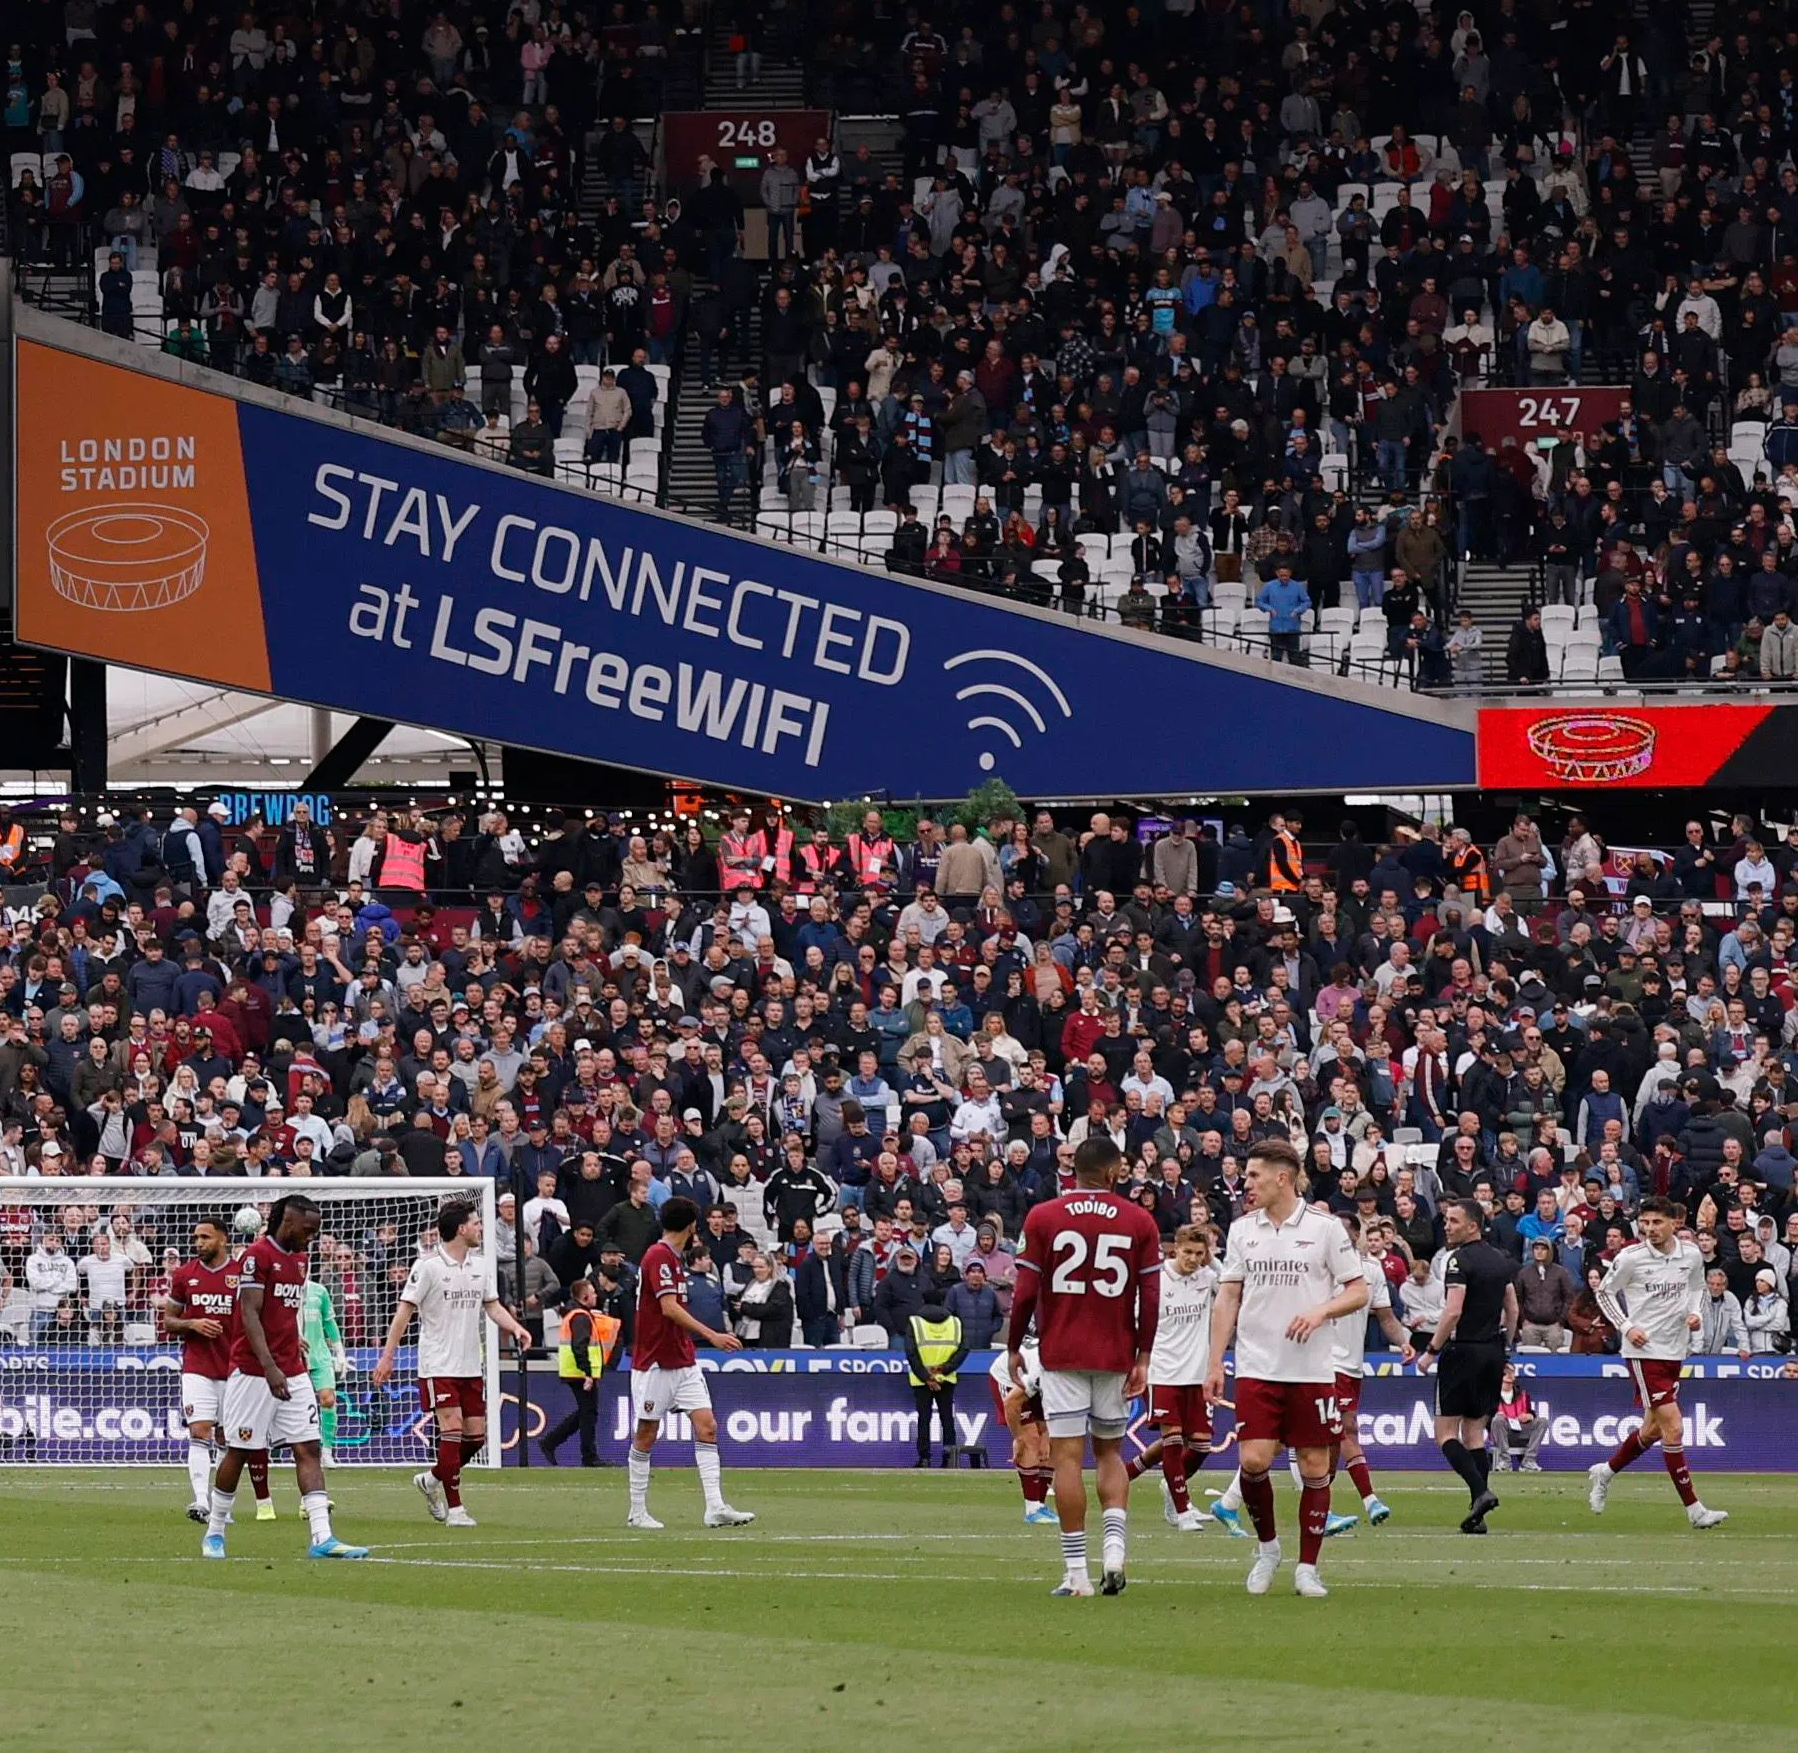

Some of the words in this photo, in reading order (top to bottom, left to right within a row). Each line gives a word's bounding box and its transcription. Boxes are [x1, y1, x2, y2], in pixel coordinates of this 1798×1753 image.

[718, 120, 776, 148] 248
[1519, 397, 1581, 426] 247
[60, 436, 197, 463] LONDON
[61, 465, 197, 492] STADIUM
[307, 462, 482, 564] STAY
[490, 513, 911, 687] CONNECTED
[348, 582, 419, 649] at
[431, 594, 829, 767] LSFreeWIFI
[1064, 1201, 1118, 1219] TODIBO
[1052, 1229, 1133, 1298] 25
[1245, 1258, 1309, 1274] Emirates
[1268, 1274, 1300, 1287] BETTER
[191, 1294, 233, 1307] BOYLE
[444, 1289, 483, 1301] Emirates
[205, 1305, 233, 1316] SPORTS
[1314, 1397, 1341, 1424] 14
[726, 1408, 812, 1443] our
